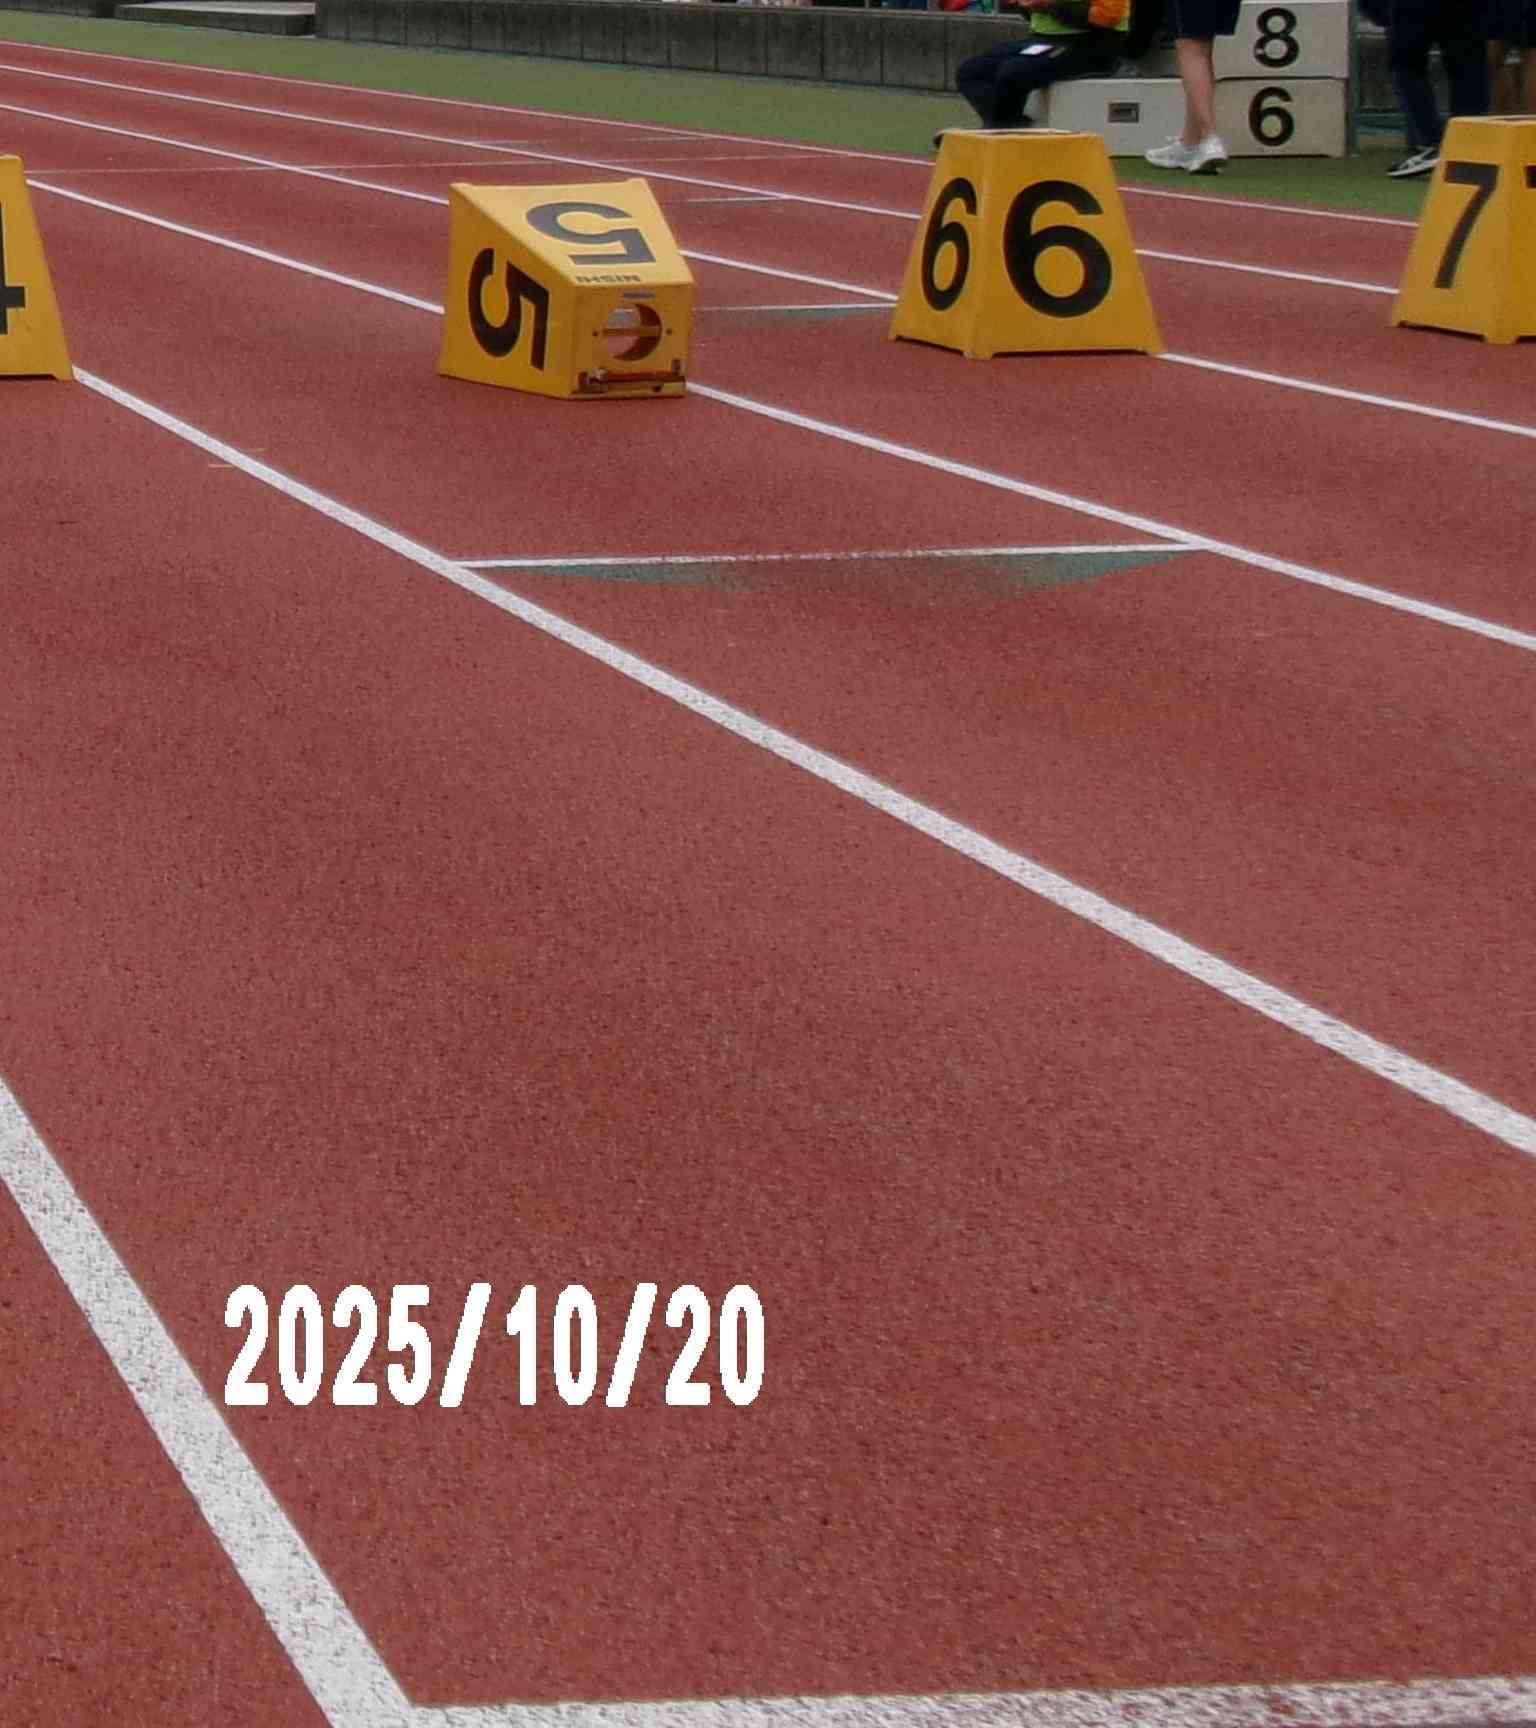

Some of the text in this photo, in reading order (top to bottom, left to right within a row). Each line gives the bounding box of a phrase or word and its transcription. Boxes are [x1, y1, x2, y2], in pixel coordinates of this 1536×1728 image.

[1254, 7, 1300, 68] 8
[1248, 86, 1295, 147] 6
[525, 202, 657, 265] 5
[921, 177, 978, 312] 6
[1002, 180, 1113, 318] 6
[1434, 160, 1500, 289] 7
[468, 248, 549, 371] 5
